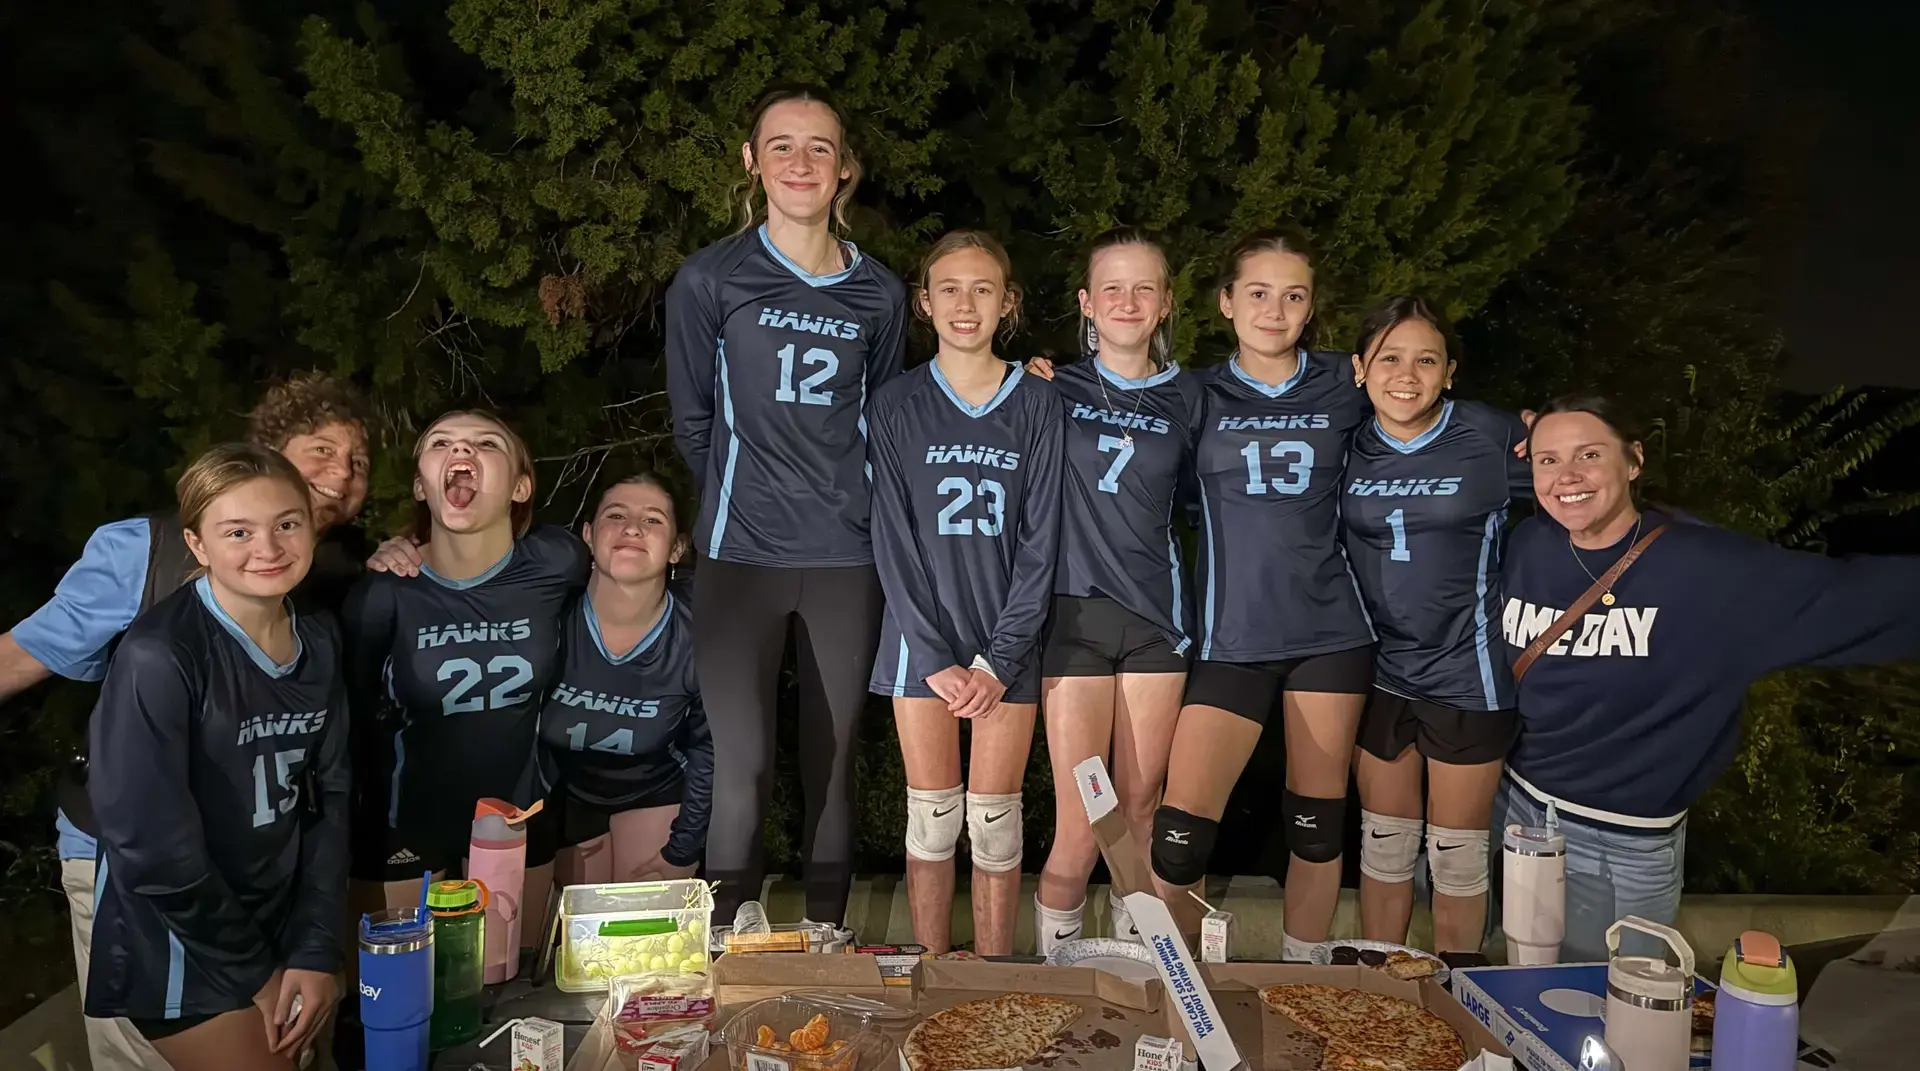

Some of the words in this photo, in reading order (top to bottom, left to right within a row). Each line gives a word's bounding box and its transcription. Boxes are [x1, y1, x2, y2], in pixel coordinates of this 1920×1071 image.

[758, 307, 860, 340] HAWKS
[775, 343, 839, 406] 12
[1071, 402, 1171, 434] HAWKS
[1217, 413, 1330, 431] HAWKS
[925, 444, 1020, 471] HAWKS
[1097, 433, 1135, 494] 7
[1240, 440, 1315, 495] 13
[1347, 476, 1463, 496] HAWKS
[937, 476, 1006, 537] 23
[1385, 508, 1411, 562] 1
[417, 618, 531, 650] HAWKS
[436, 655, 534, 717] 22
[551, 682, 660, 718] HAWKS
[237, 709, 328, 746] HAWKS
[566, 722, 635, 756] 14
[252, 748, 306, 828] 15
[1151, 934, 1178, 978] DOMINO'S
[359, 978, 382, 1001] bay
[1171, 978, 1186, 995] SAY
[1174, 961, 1196, 992] SAYING
[1179, 995, 1199, 1020] CAN'T
[1189, 994, 1215, 1033] WITHOUT
[1460, 986, 1491, 1029] LARGE
[514, 1030, 541, 1046] Honest
[1192, 1020, 1208, 1040] YOU
